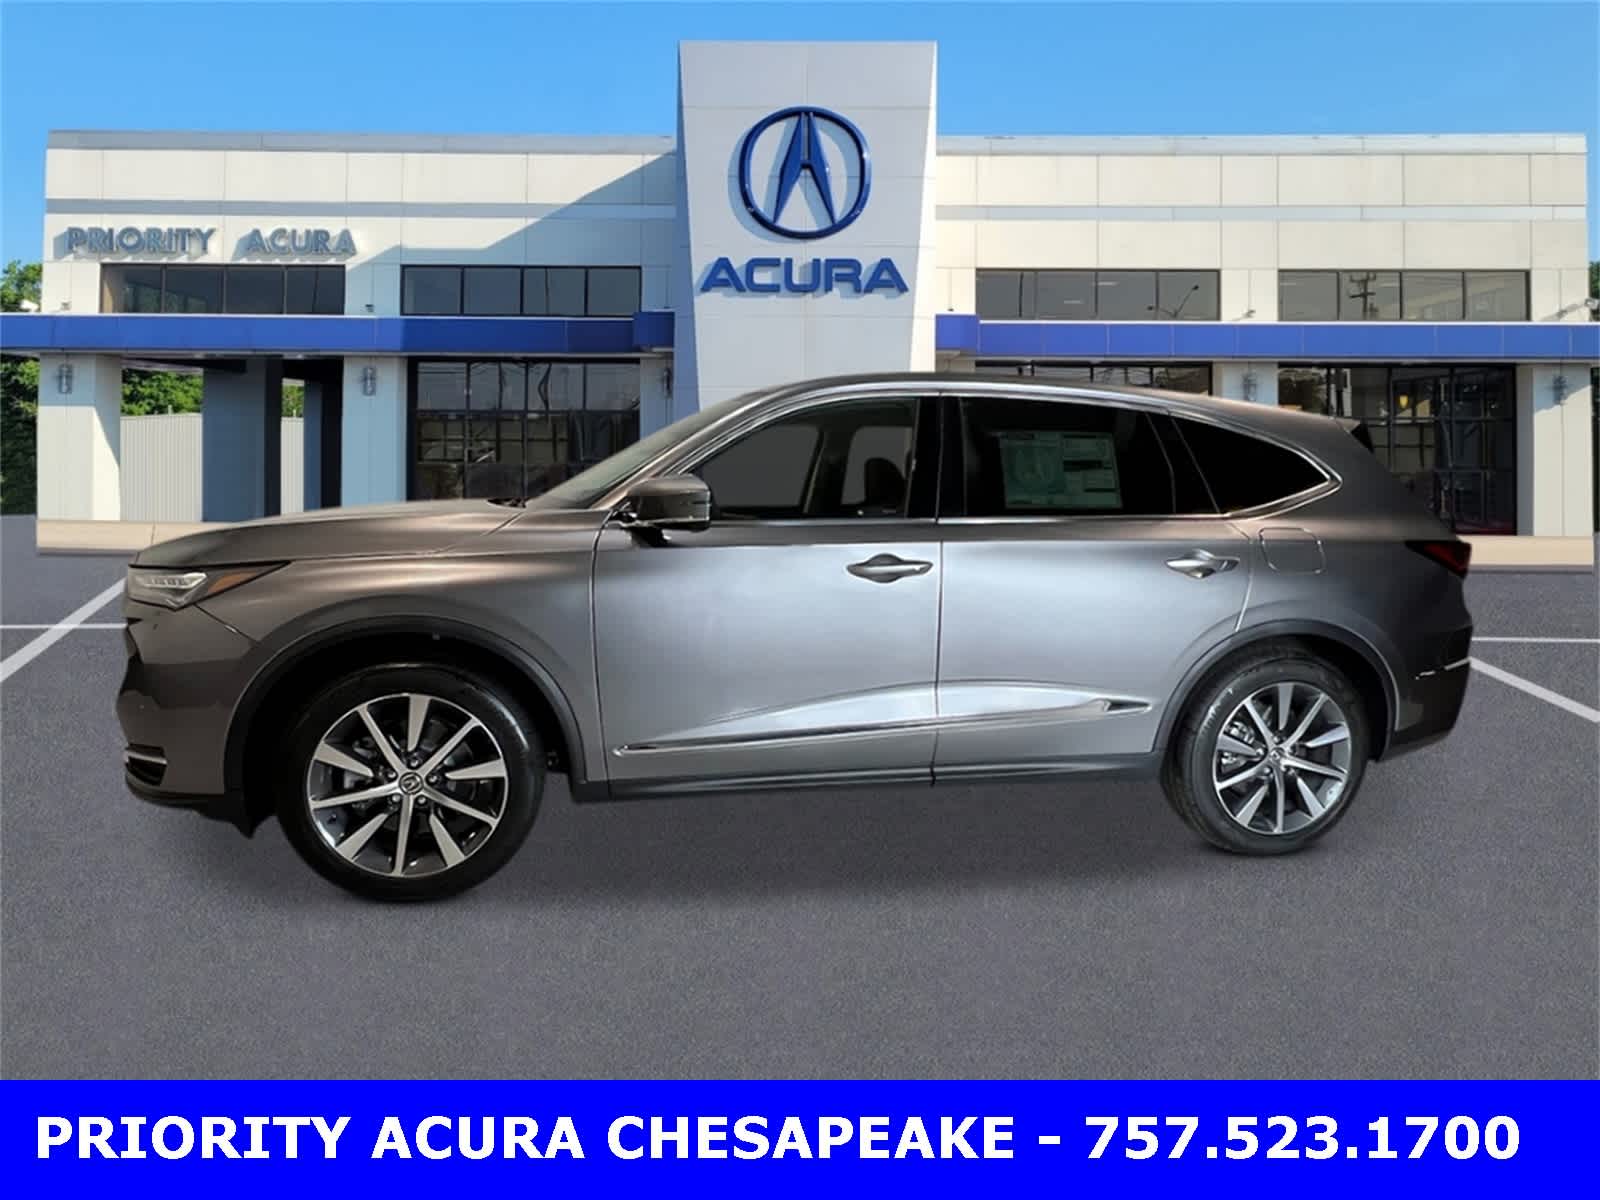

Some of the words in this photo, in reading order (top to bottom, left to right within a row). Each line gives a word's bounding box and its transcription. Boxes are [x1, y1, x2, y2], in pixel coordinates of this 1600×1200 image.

[65, 226, 216, 253] PRIORITY
[245, 227, 358, 256] ACURA
[700, 256, 909, 294] ACURA
